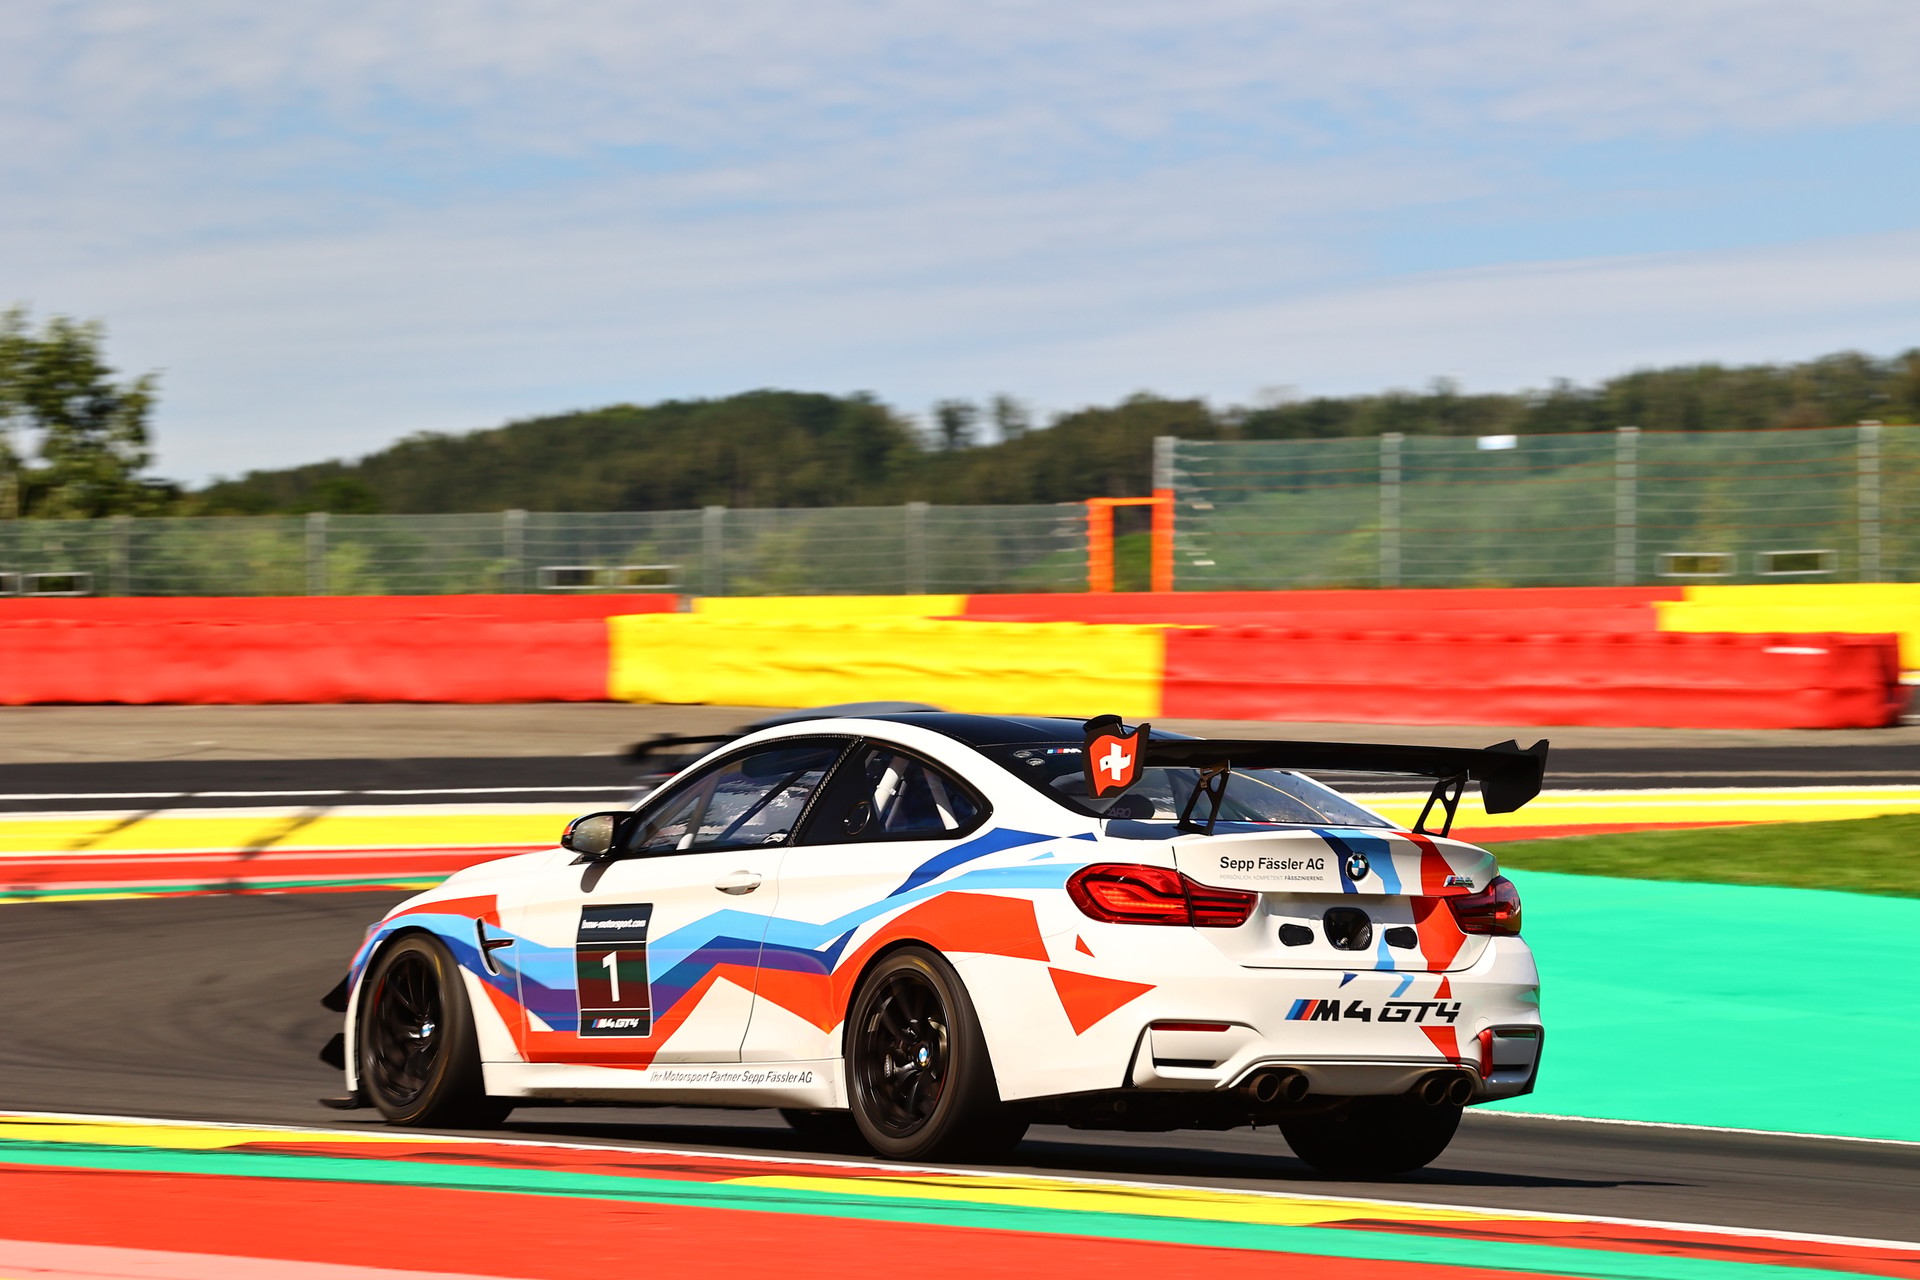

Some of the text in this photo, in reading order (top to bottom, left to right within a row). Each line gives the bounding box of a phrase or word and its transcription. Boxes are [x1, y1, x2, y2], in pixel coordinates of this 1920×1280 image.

[1220, 856, 1325, 872] Sepp Fässler AG
[602, 951, 620, 1002] 1
[1310, 1000, 1462, 1023] M4 GT4
[663, 1070, 709, 1084] Motorsport
[709, 1071, 741, 1082] Partner
[742, 1070, 765, 1084] Sepp
[765, 1071, 798, 1083] Fässler
[798, 1071, 813, 1083] AG
